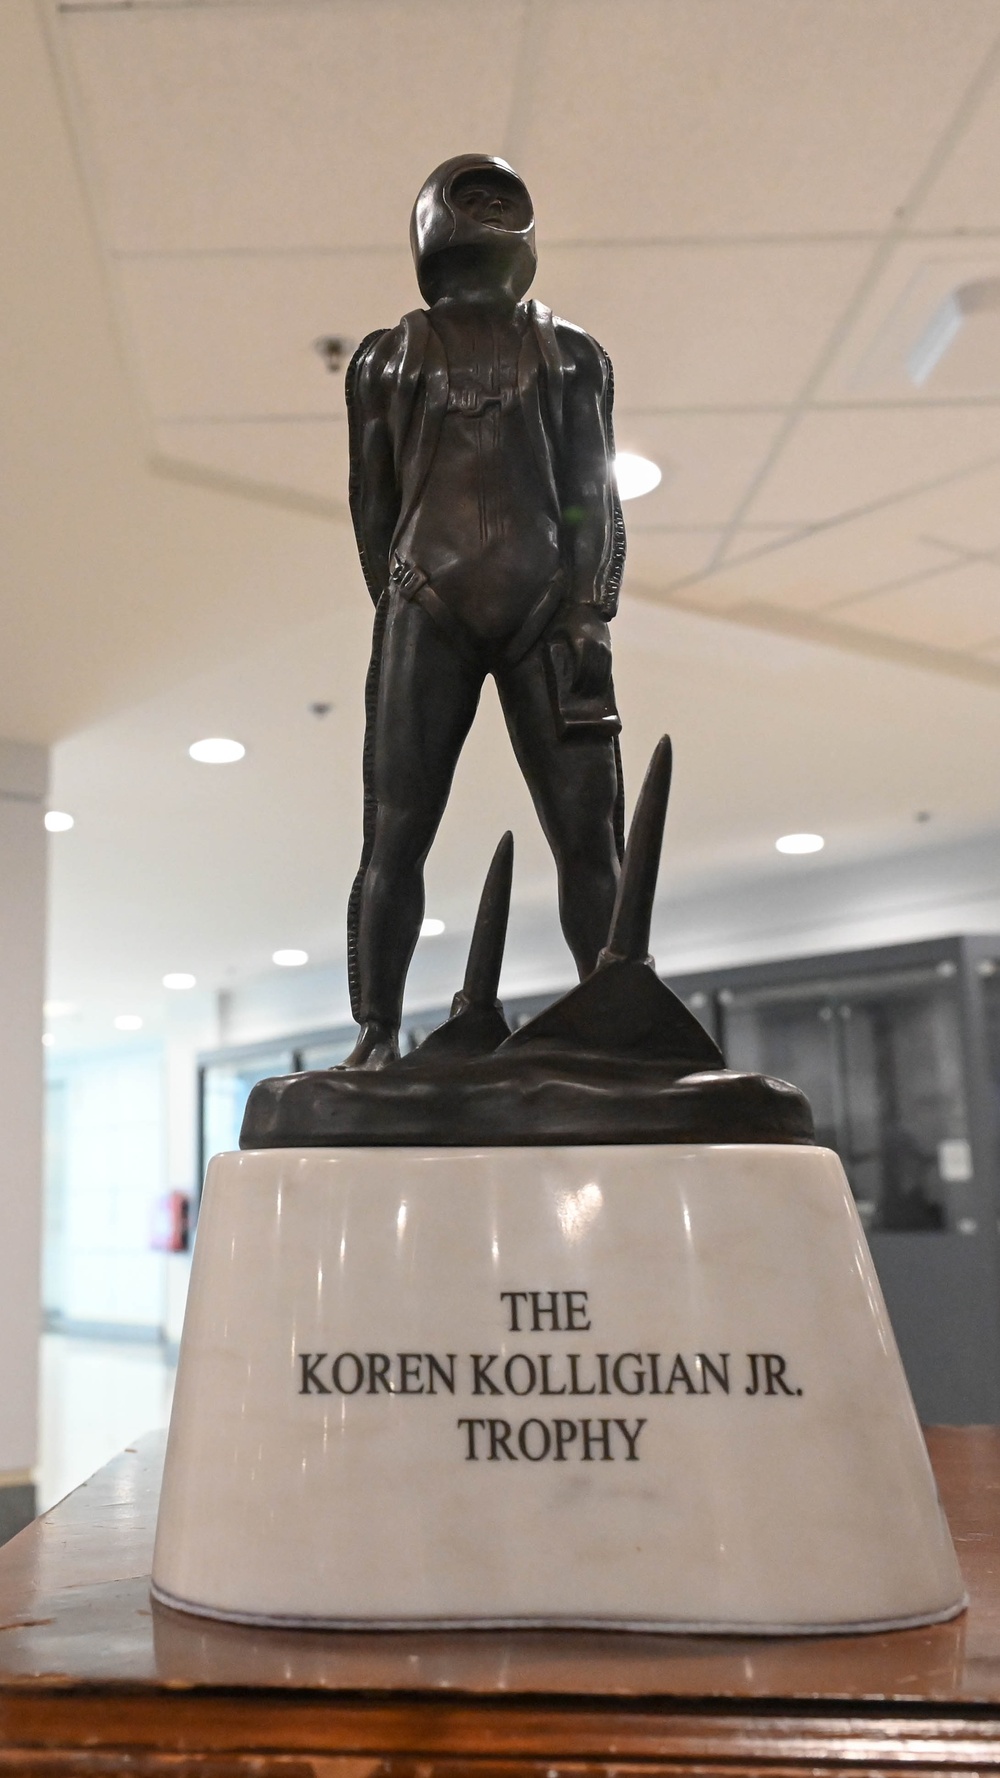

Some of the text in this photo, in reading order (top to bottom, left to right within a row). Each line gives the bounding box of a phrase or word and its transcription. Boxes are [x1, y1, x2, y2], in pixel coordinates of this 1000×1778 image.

[500, 1290, 592, 1332] THE
[298, 1352, 804, 1397] KOREN KOLLIGIAN JR.
[457, 1417, 648, 1462] TROPHY
